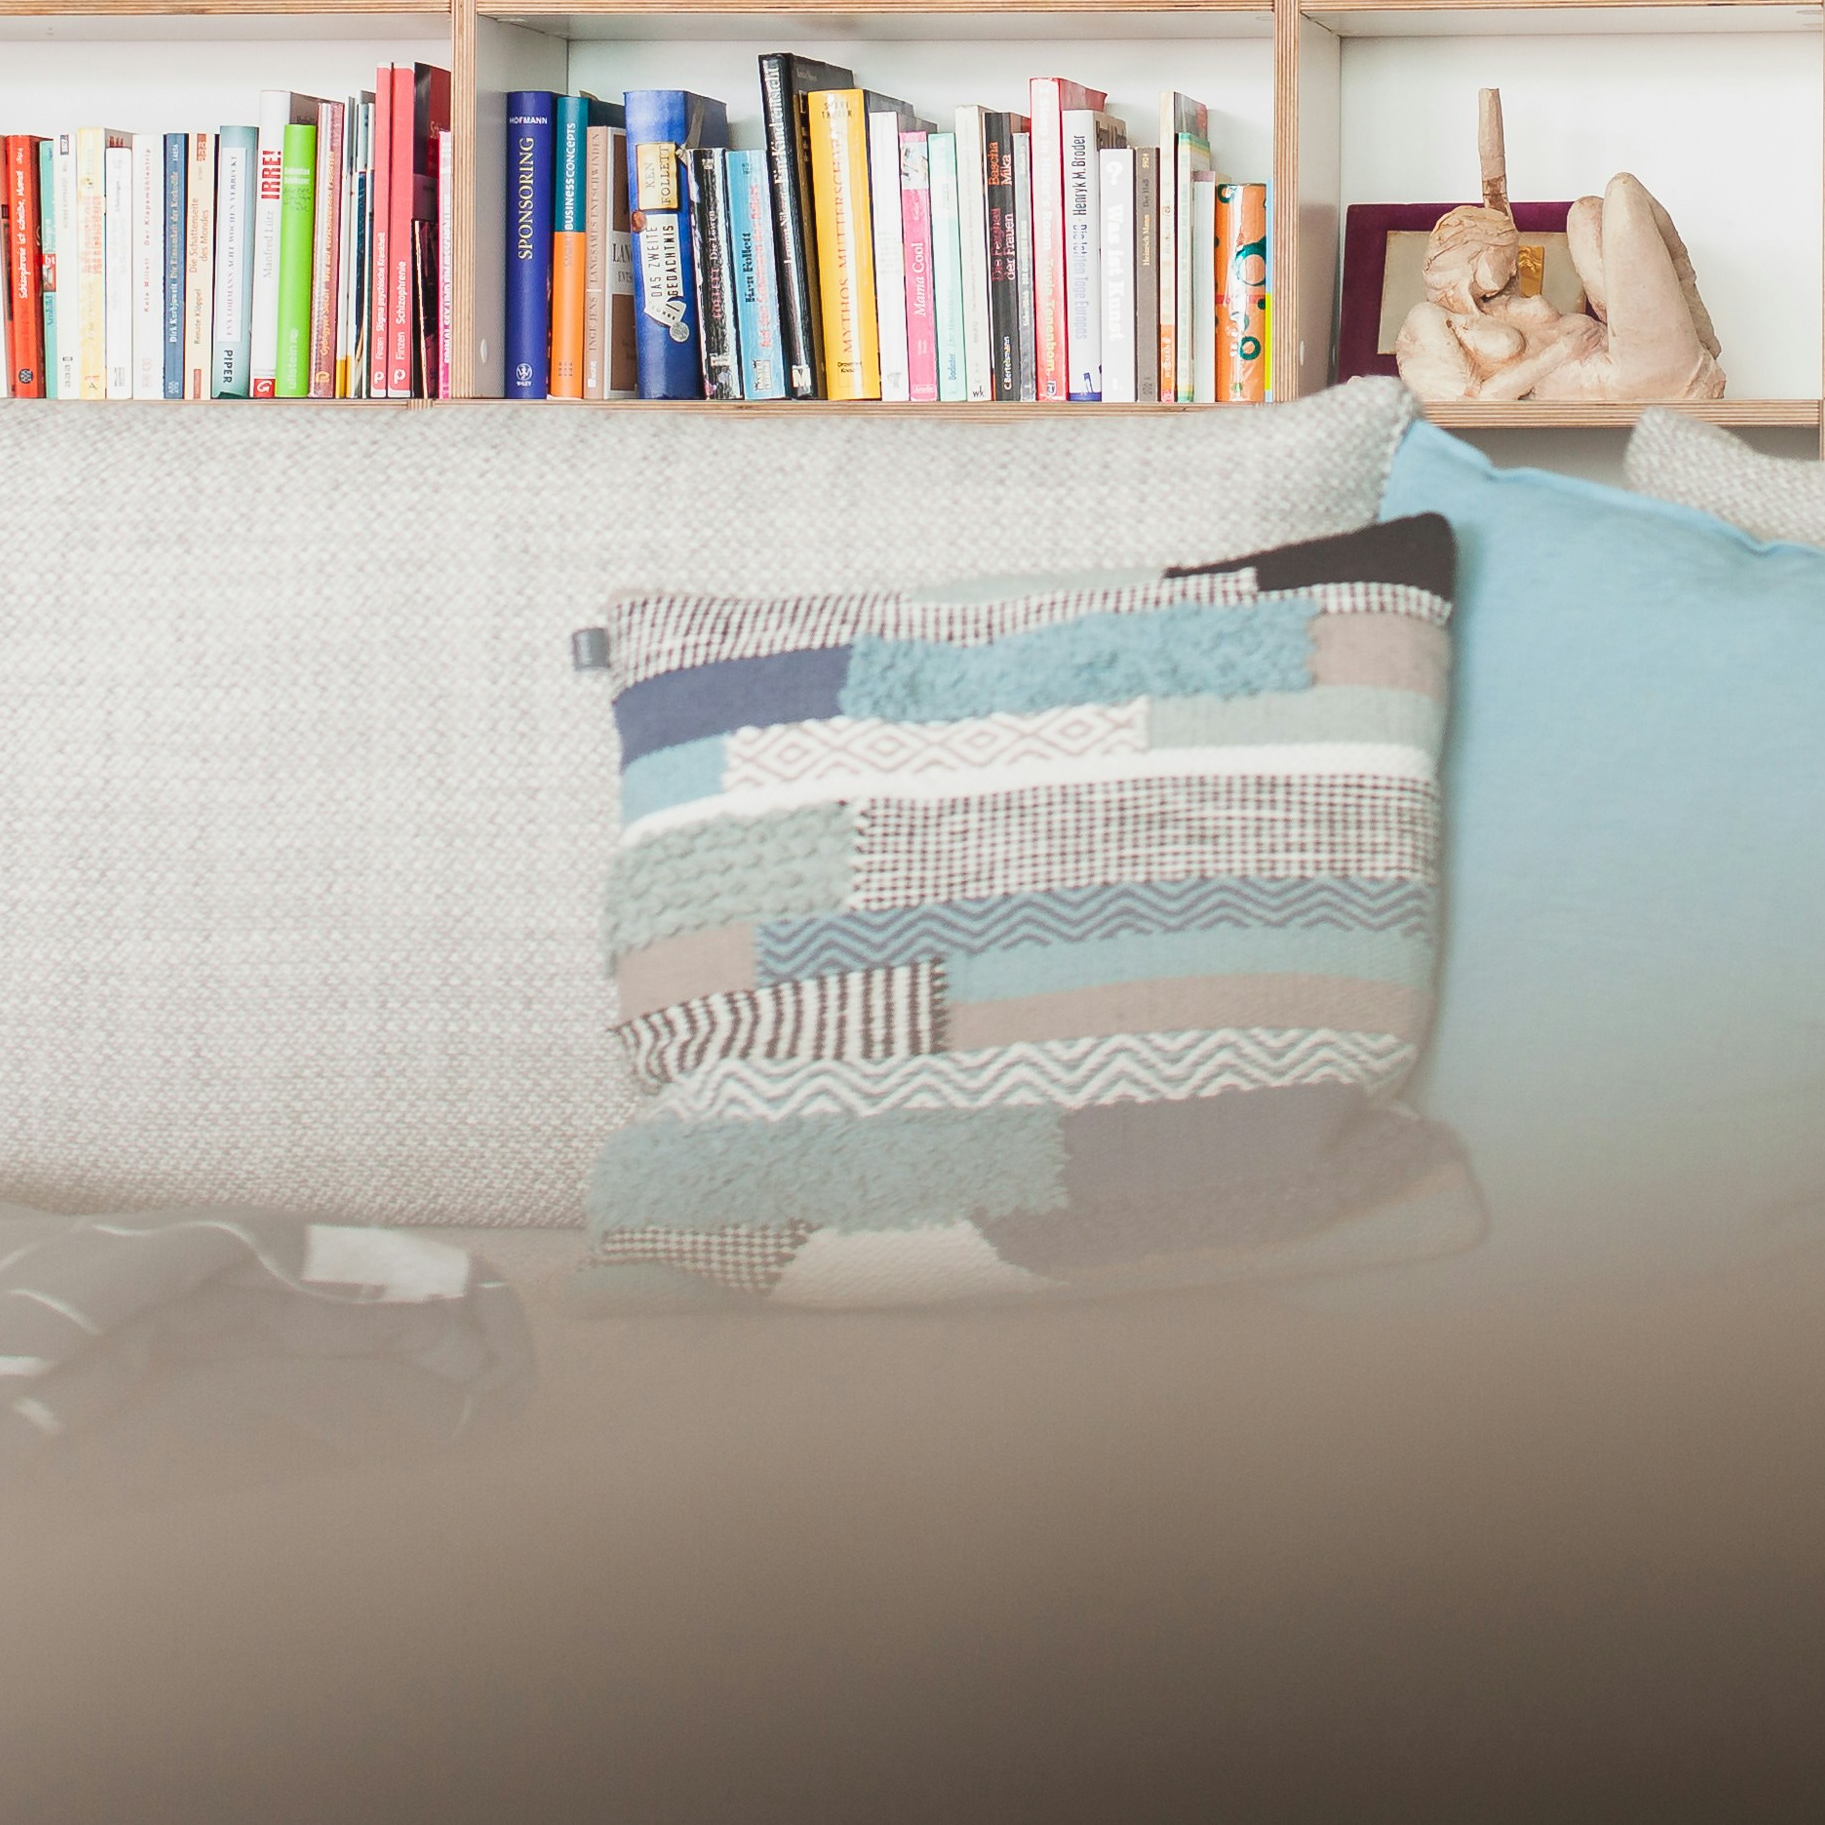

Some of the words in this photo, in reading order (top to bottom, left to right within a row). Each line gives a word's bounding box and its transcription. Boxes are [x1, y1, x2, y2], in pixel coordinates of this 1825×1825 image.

[260, 150, 281, 200] IRRE!
[642, 164, 656, 189] KEN
[656, 146, 672, 204] FOLLETT
[517, 137, 535, 259] SPONSORING
[646, 226, 661, 268] ZWEITE
[911, 243, 925, 274] Cool
[395, 262, 409, 324] Schizophrenie
[649, 277, 663, 297] DAS
[913, 276, 928, 316] Mama
[394, 332, 406, 360] Finzen
